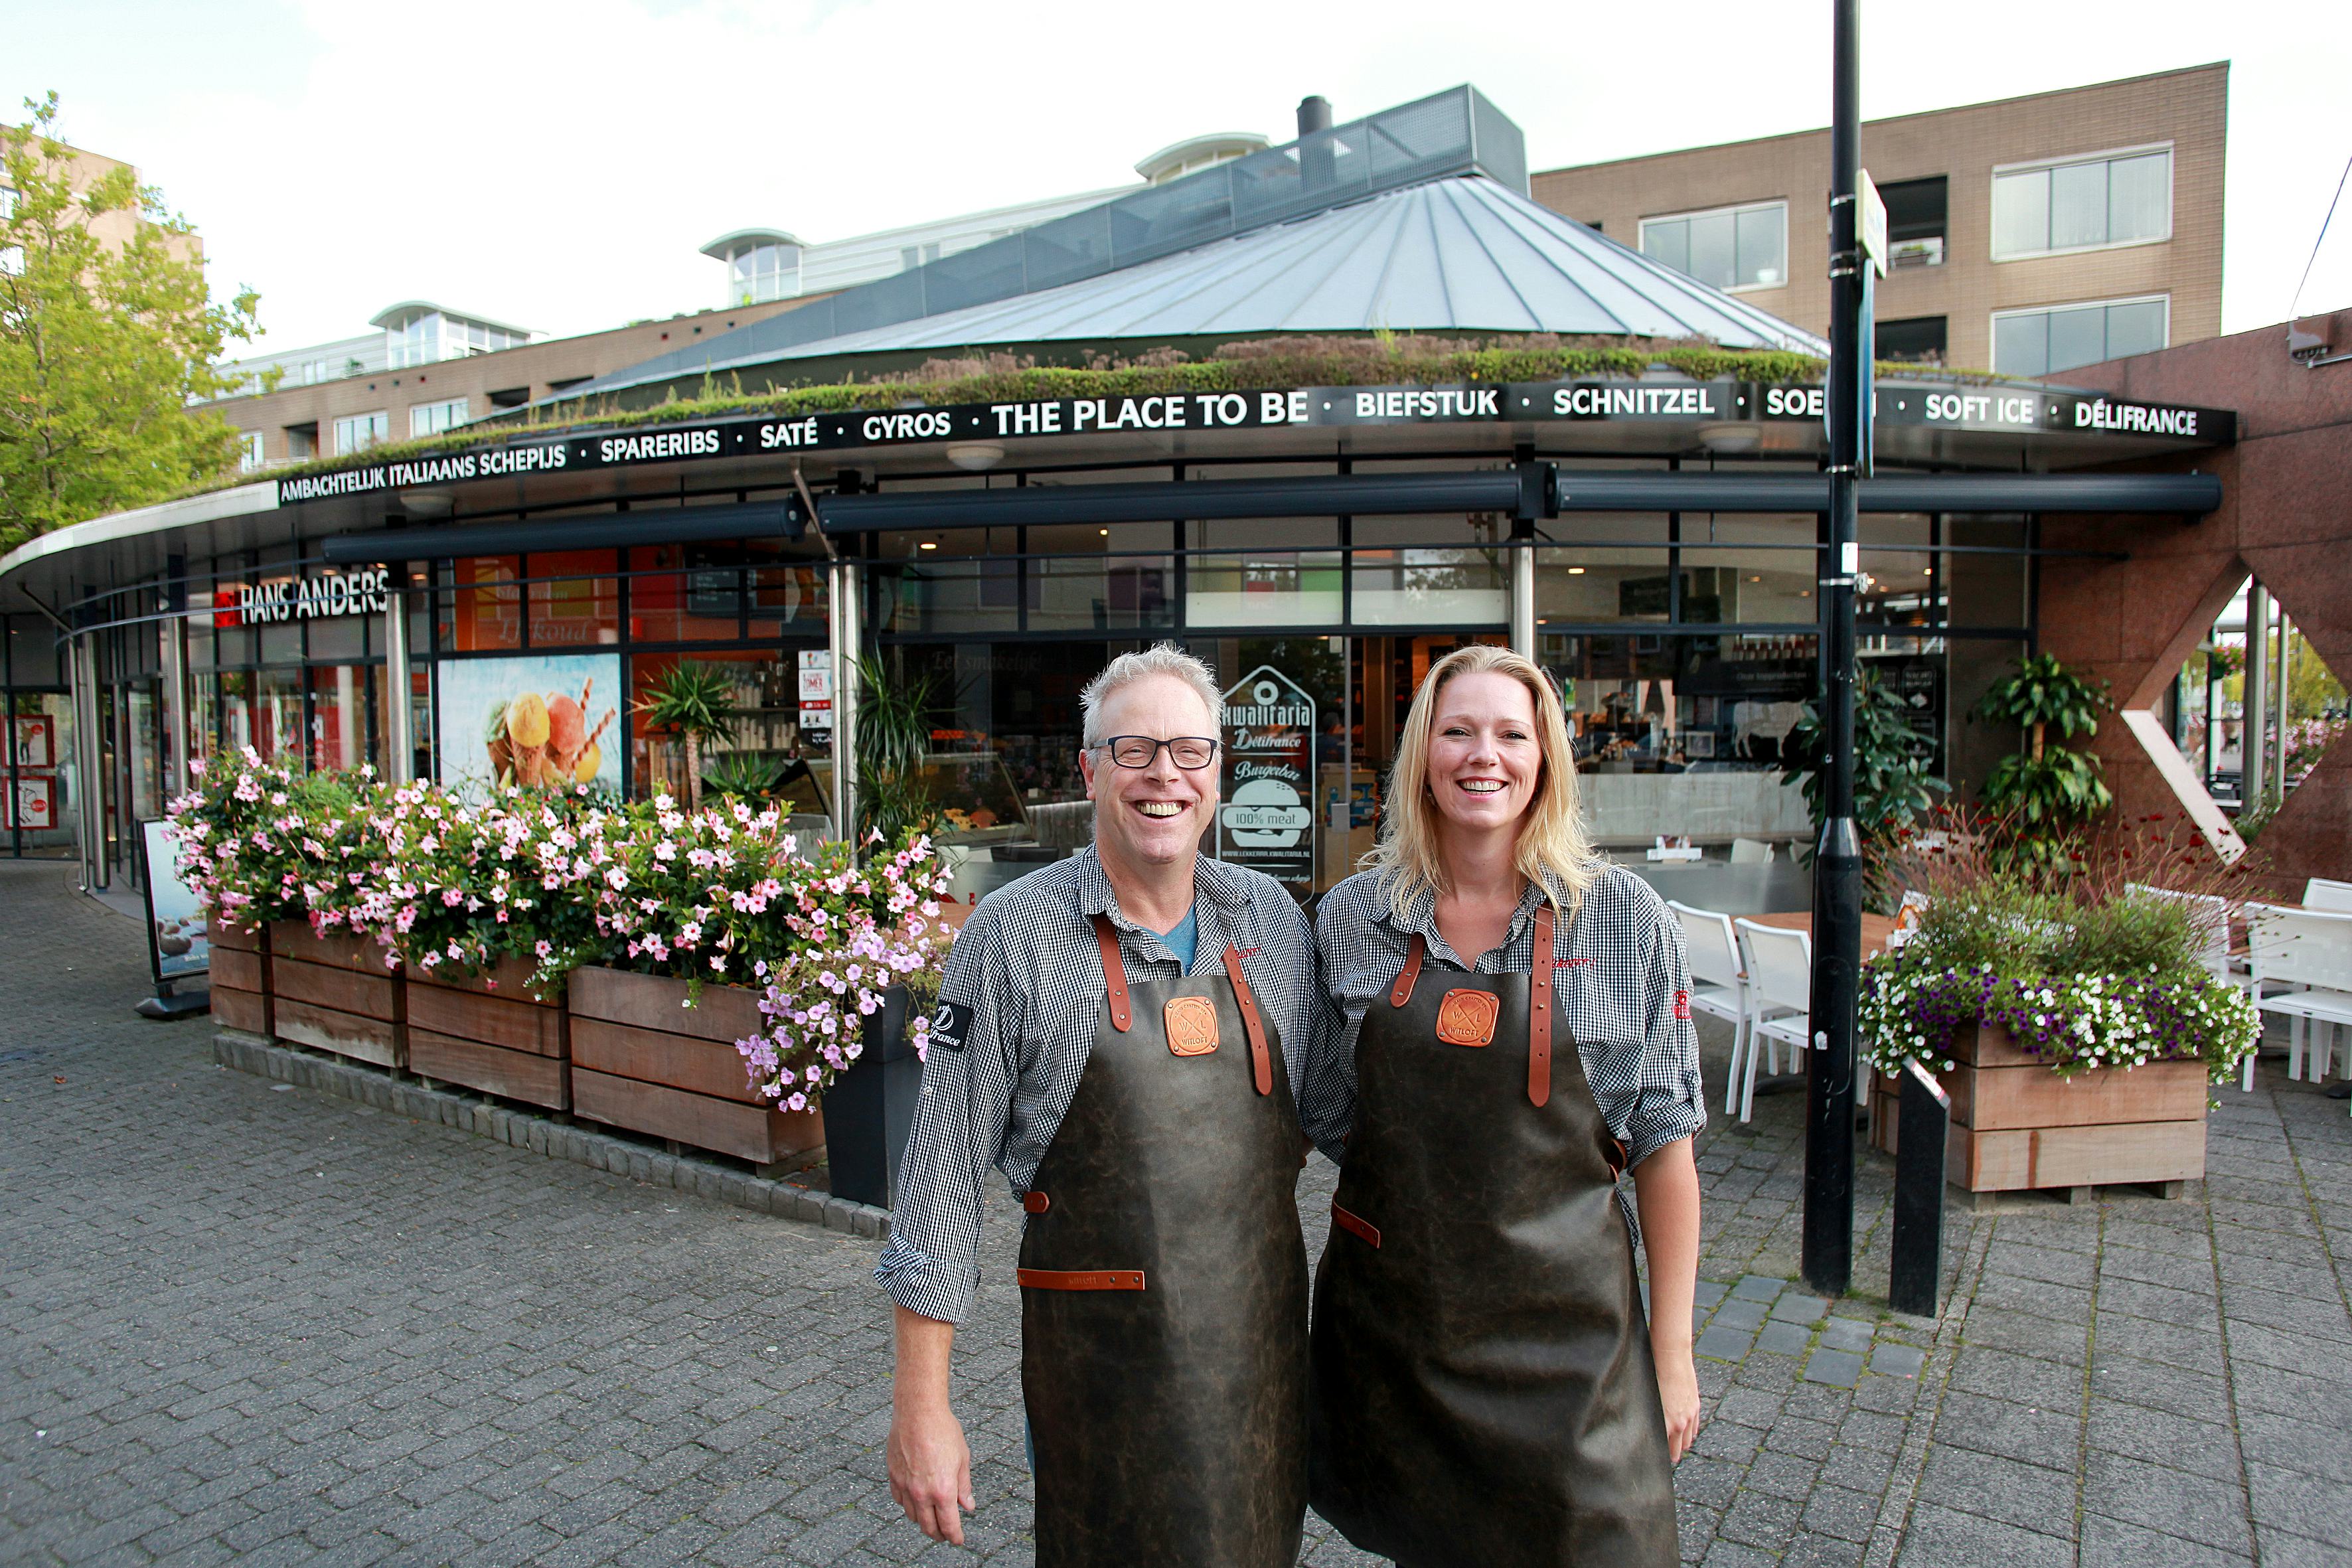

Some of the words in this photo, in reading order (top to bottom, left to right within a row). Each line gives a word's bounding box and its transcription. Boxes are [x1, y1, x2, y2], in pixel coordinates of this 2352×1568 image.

[280, 467, 385, 502] AMBACHTELIJK
[389, 455, 475, 487] ITALIAANS
[479, 445, 566, 475] SCHEPIJS
[601, 430, 720, 463] SPARERIBS
[761, 417, 818, 448] SATÉ
[862, 413, 951, 441] GYROS
[991, 402, 1061, 435] THE
[1073, 396, 1186, 431] PLACE
[1196, 394, 1247, 426] TO
[1260, 391, 1309, 424] BE
[1355, 390, 1499, 417] BIEFSTUK
[1553, 388, 1715, 415] SCHNITZEL
[1926, 394, 1990, 421] SOFT
[1997, 398, 2033, 424] ICE
[2075, 398, 2197, 435] DÉLIFRANCE
[240, 582, 289, 625] HANS
[296, 569, 389, 619] ANDERS
[499, 616, 590, 645] IJkoud
[1222, 701, 1310, 726] kwalitaria
[1235, 760, 1301, 782] Burgerbar
[1235, 813, 1264, 825] 100%
[1267, 813, 1296, 825] meat
[1452, 1010, 1462, 1020] W
[1475, 1014, 1481, 1023] L
[1179, 1022, 1188, 1031] W
[1200, 1020, 1206, 1030] L
[1449, 1026, 1479, 1037] WITLOFT
[1181, 1036, 1208, 1046] WITLOFT
